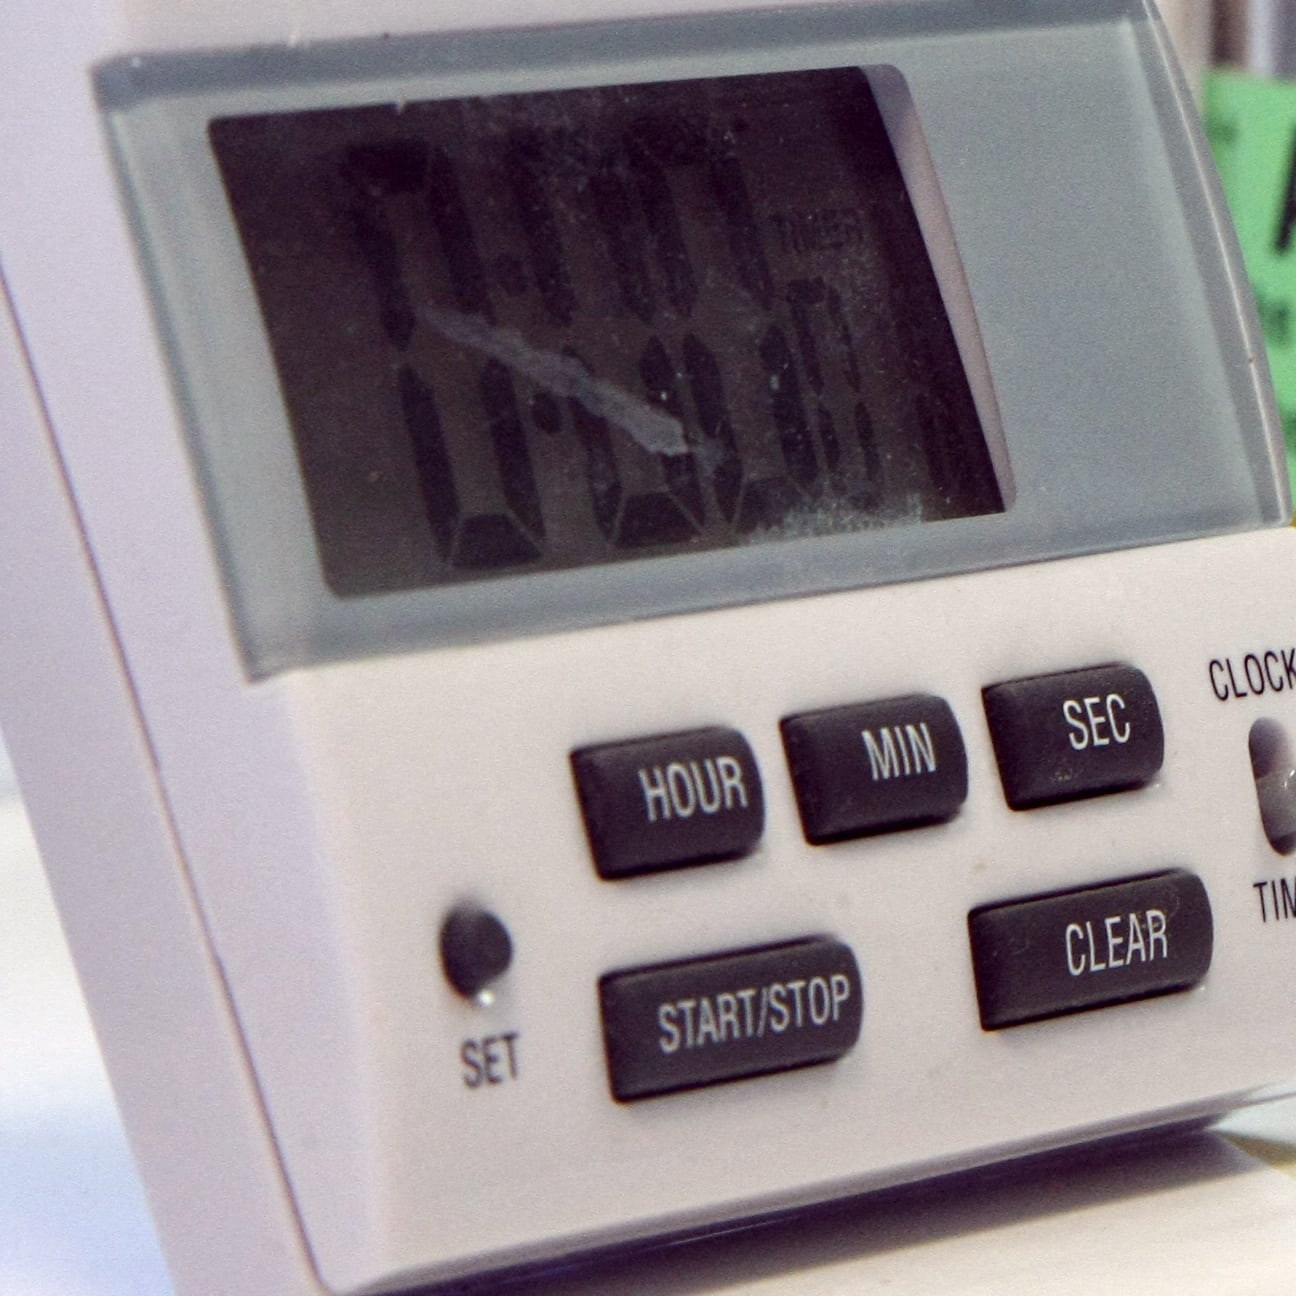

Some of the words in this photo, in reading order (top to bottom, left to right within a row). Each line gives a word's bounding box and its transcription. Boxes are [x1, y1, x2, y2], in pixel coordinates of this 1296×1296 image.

[861, 722, 937, 781] MIN
[1062, 693, 1131, 751] SEC
[638, 756, 748, 823] HOUR
[1065, 909, 1169, 977] CLEAR
[657, 974, 851, 1054] START/STOP
[460, 1032, 519, 1090] SET
